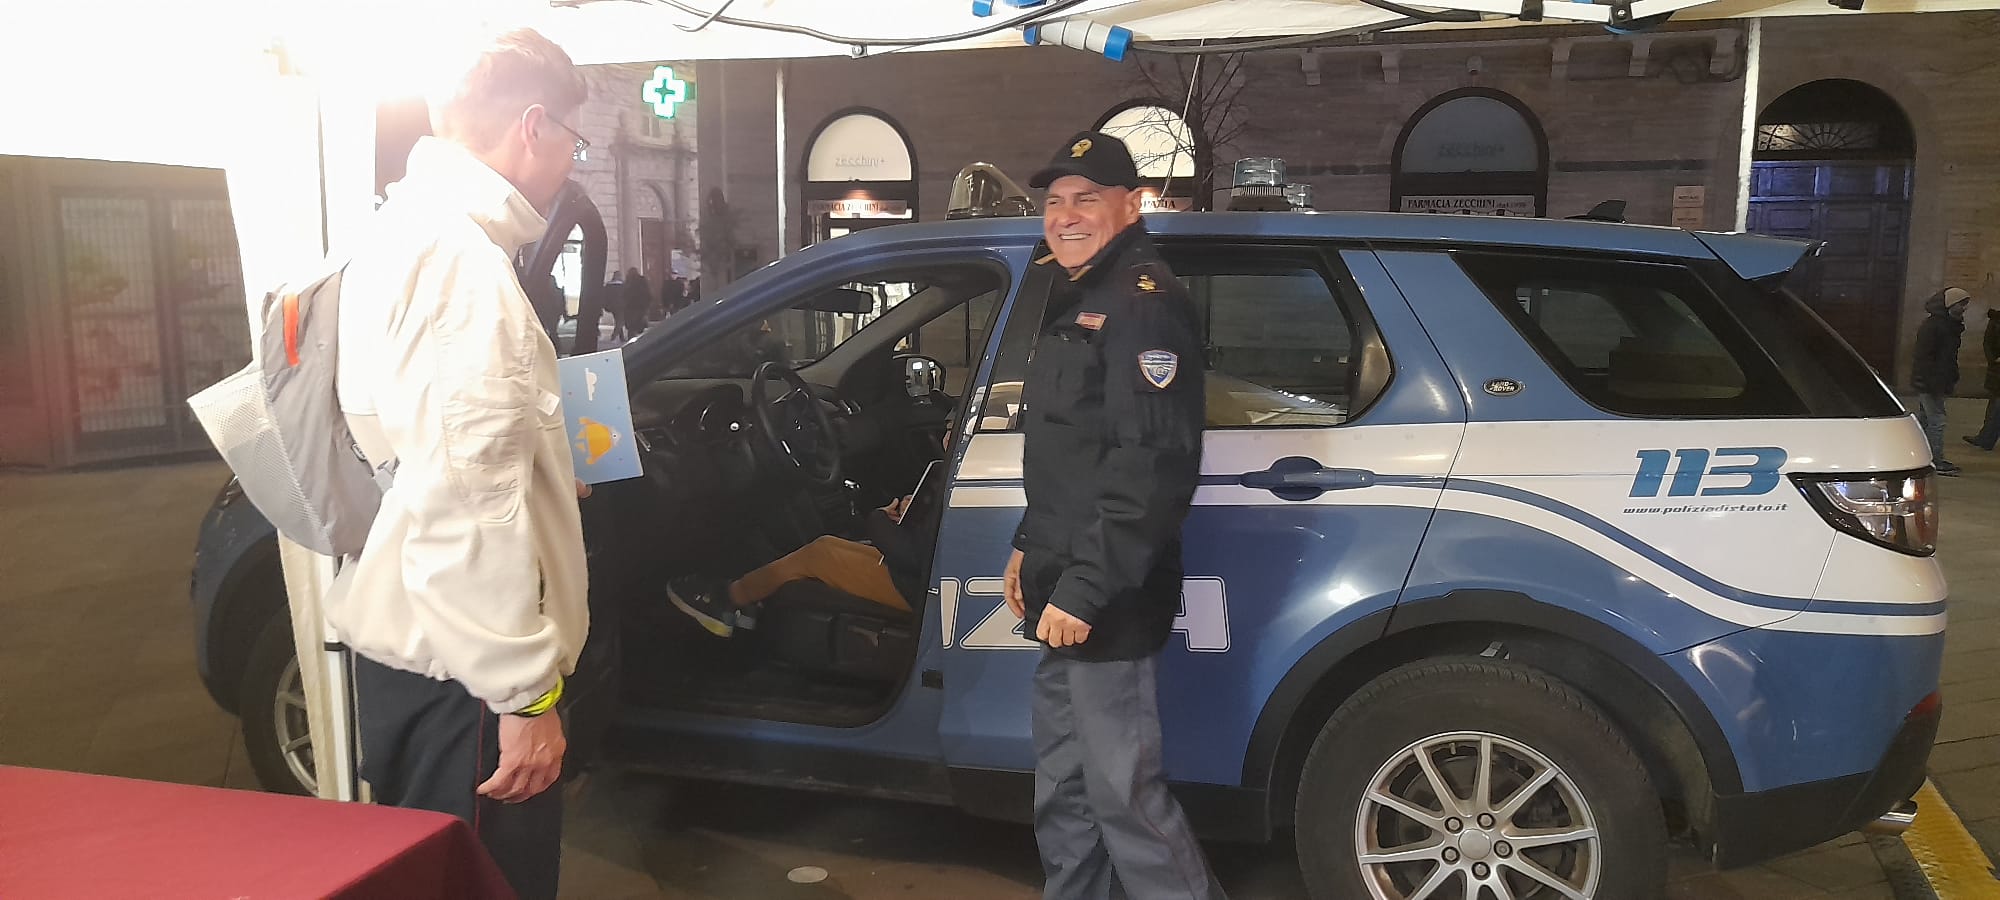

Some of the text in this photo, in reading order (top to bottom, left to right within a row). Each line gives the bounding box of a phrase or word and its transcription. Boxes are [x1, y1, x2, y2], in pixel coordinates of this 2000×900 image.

[1408, 199, 1451, 209] FARMACIA
[1453, 198, 1495, 208] ZECCHINI
[1628, 447, 1788, 497] 113
[1623, 503, 1788, 515] www.poliziadistato.it
